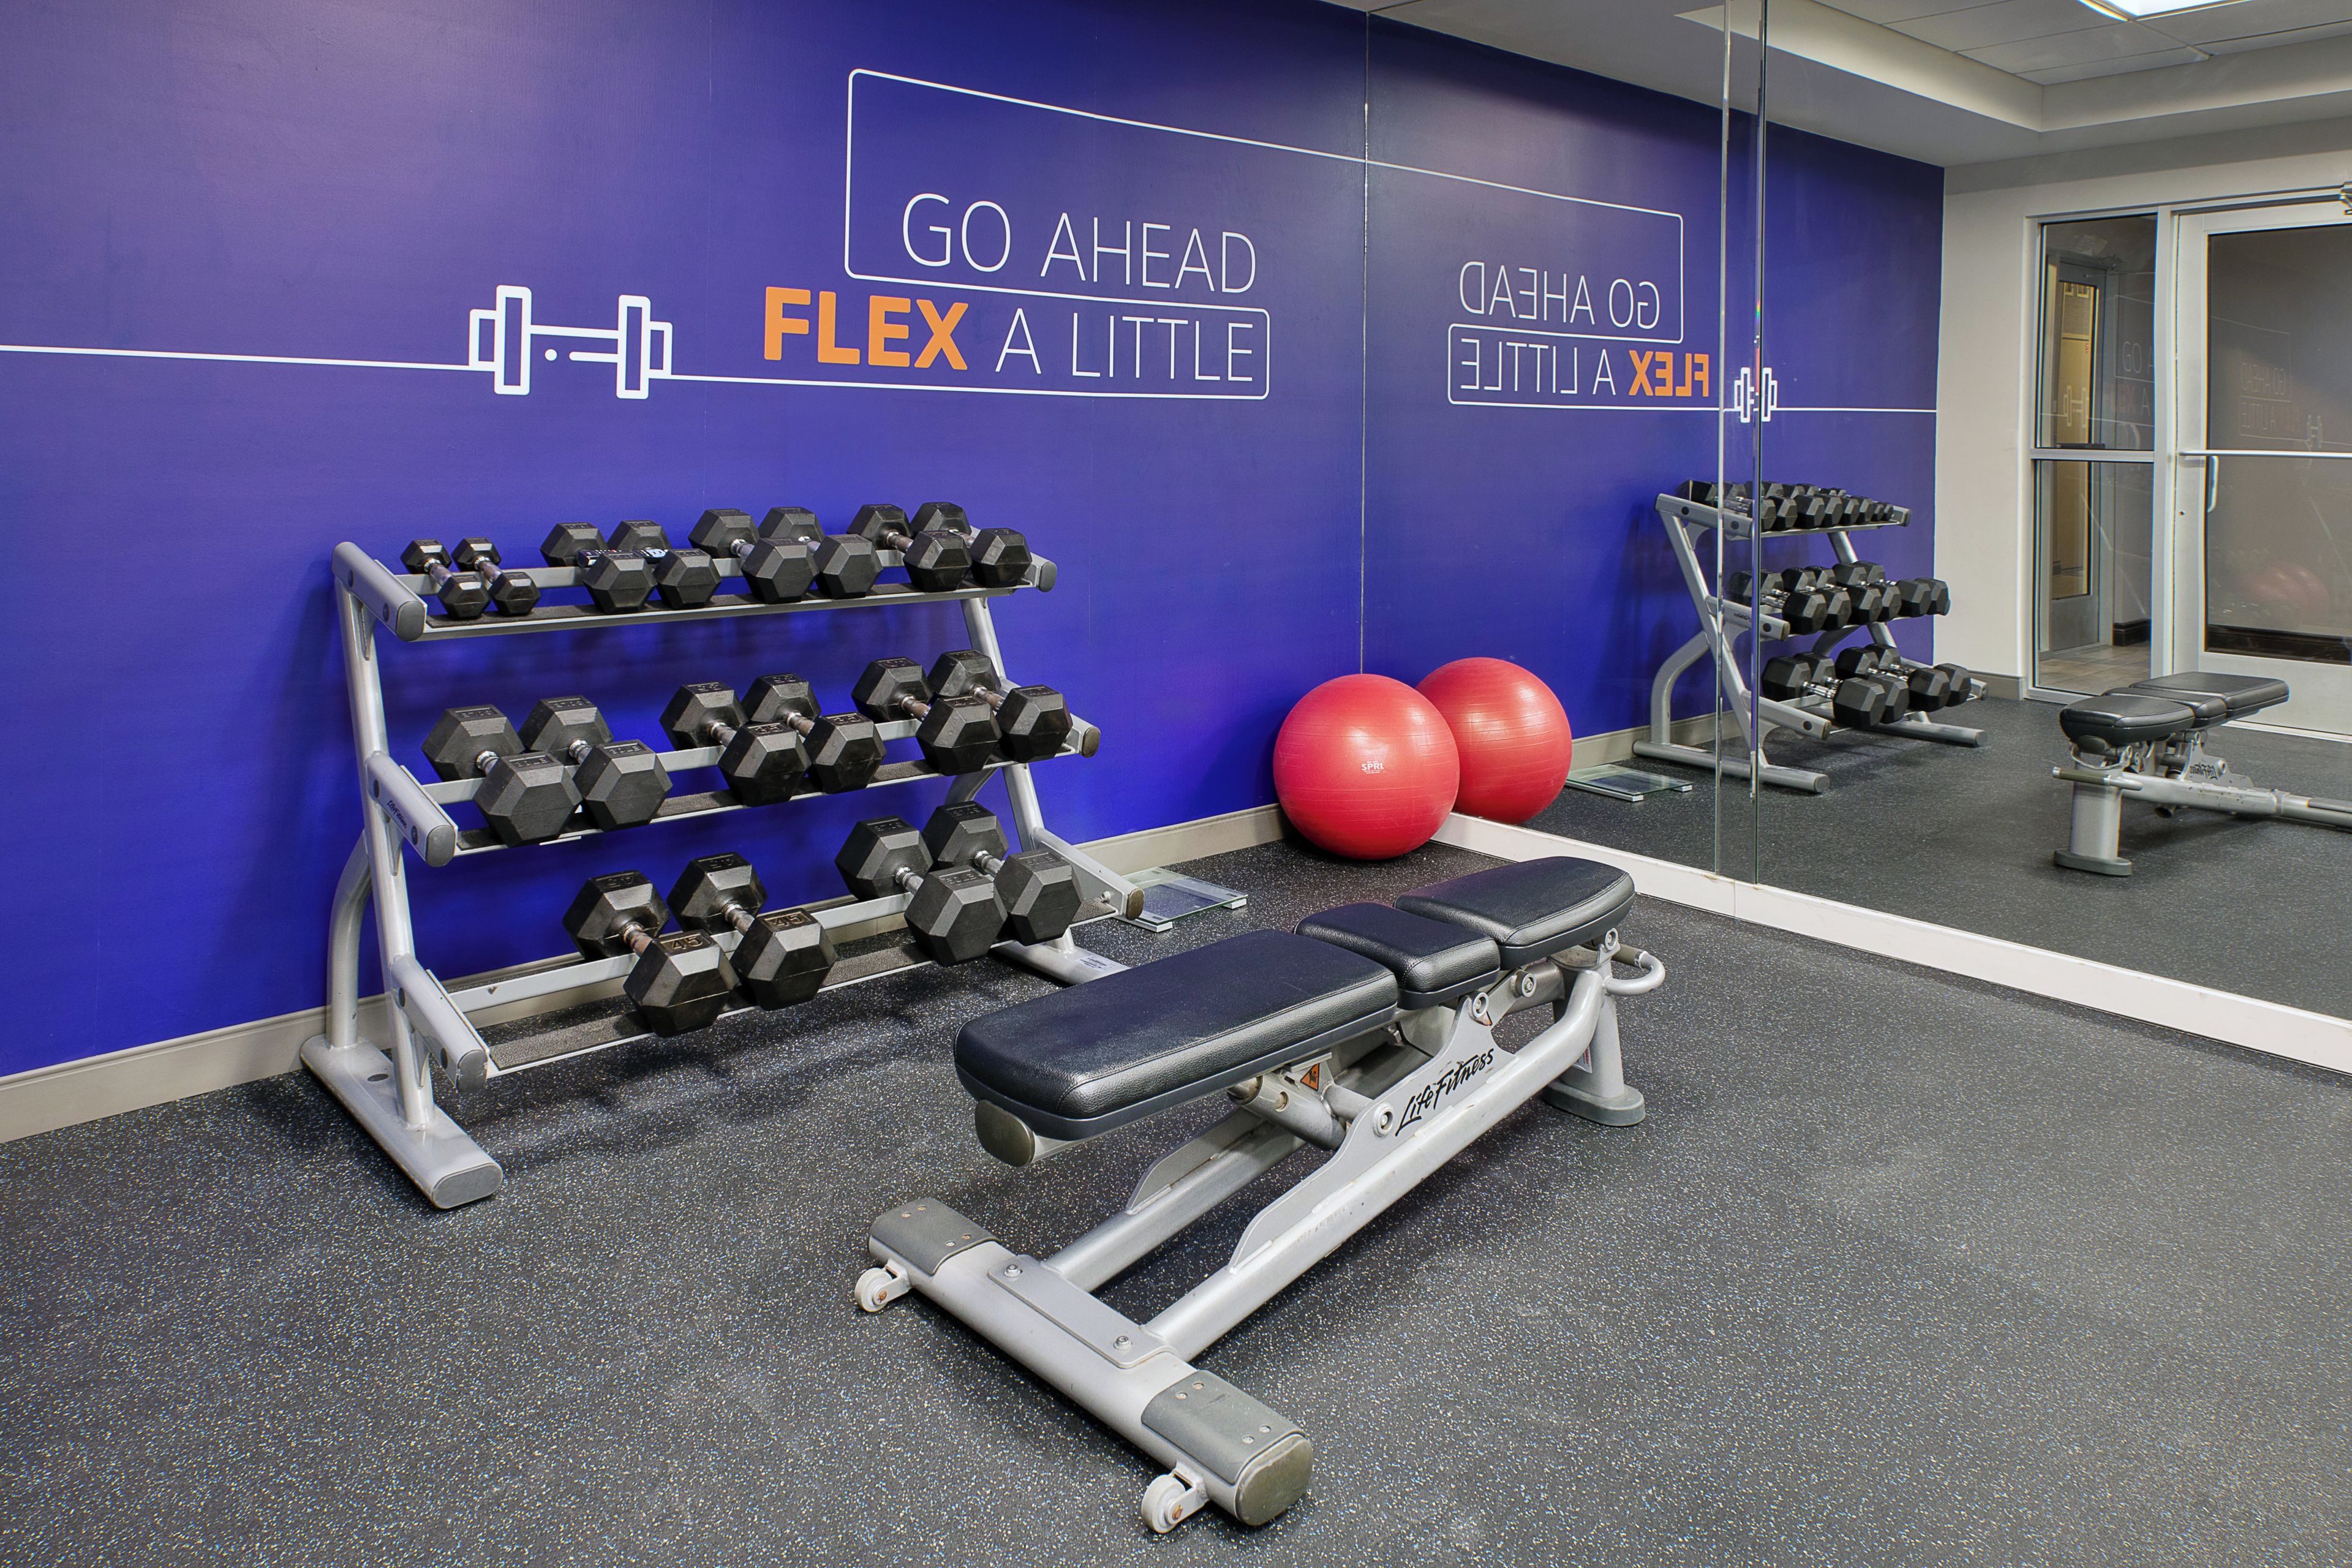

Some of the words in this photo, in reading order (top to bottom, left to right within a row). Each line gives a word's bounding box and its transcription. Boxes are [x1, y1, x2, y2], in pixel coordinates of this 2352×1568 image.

[902, 193, 1011, 273] GO
[1039, 212, 1257, 293] AHEAD
[764, 286, 968, 371] FLEX
[995, 307, 1042, 375] A
[1071, 312, 1254, 382] LITTLE
[2122, 341, 2142, 373] GO
[833, 715, 861, 724] 35
[755, 725, 784, 734] 35
[775, 913, 804, 927] 45
[672, 936, 703, 949] 45
